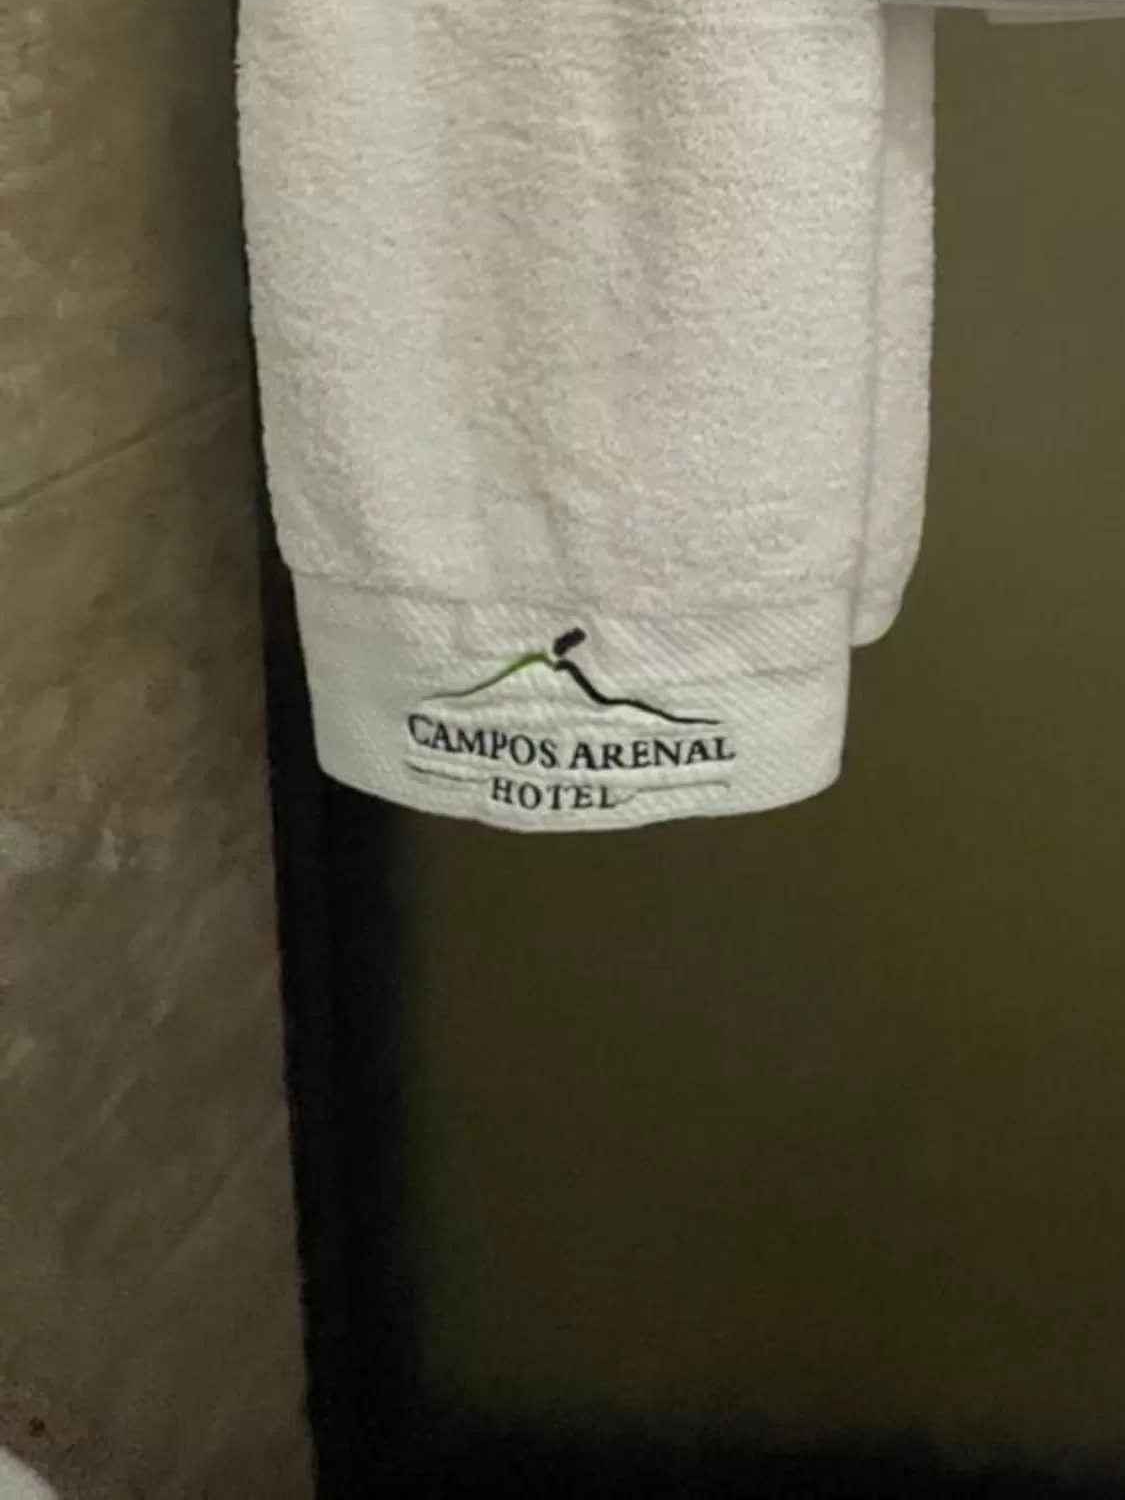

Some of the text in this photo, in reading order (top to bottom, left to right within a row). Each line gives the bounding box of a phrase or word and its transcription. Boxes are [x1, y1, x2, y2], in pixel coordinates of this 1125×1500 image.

[407, 713, 736, 771] CAMPOS ARENAL
[490, 777, 618, 810] HOTEL
